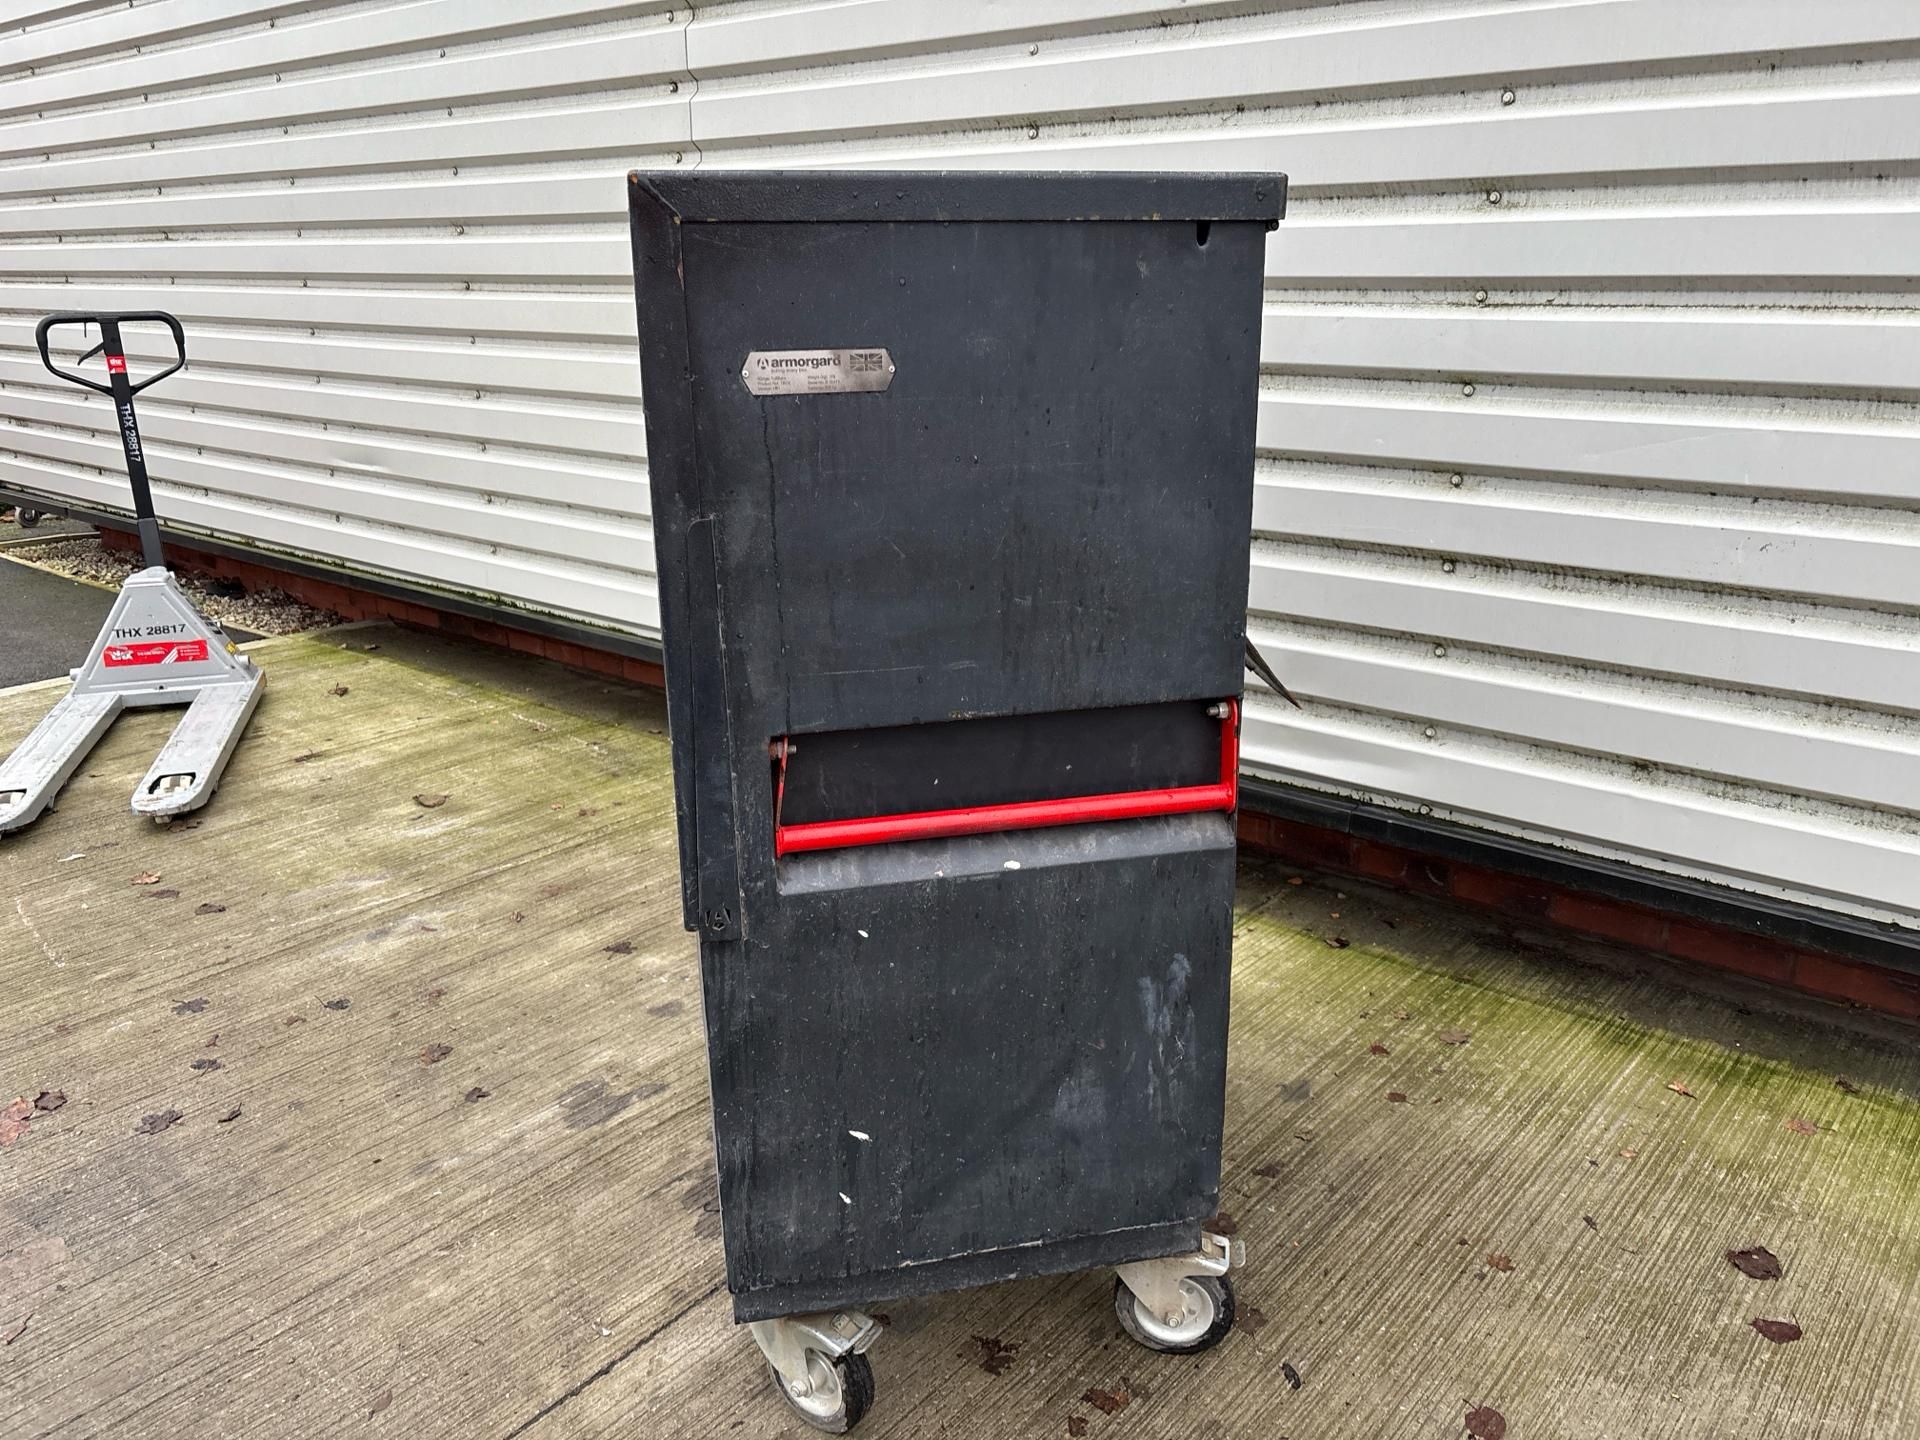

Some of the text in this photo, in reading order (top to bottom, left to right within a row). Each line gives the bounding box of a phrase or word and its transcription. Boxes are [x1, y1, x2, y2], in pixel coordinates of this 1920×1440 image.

[771, 354, 841, 369] armorgard
[120, 403, 141, 462] THX 28817
[113, 624, 187, 639] THX 28817
